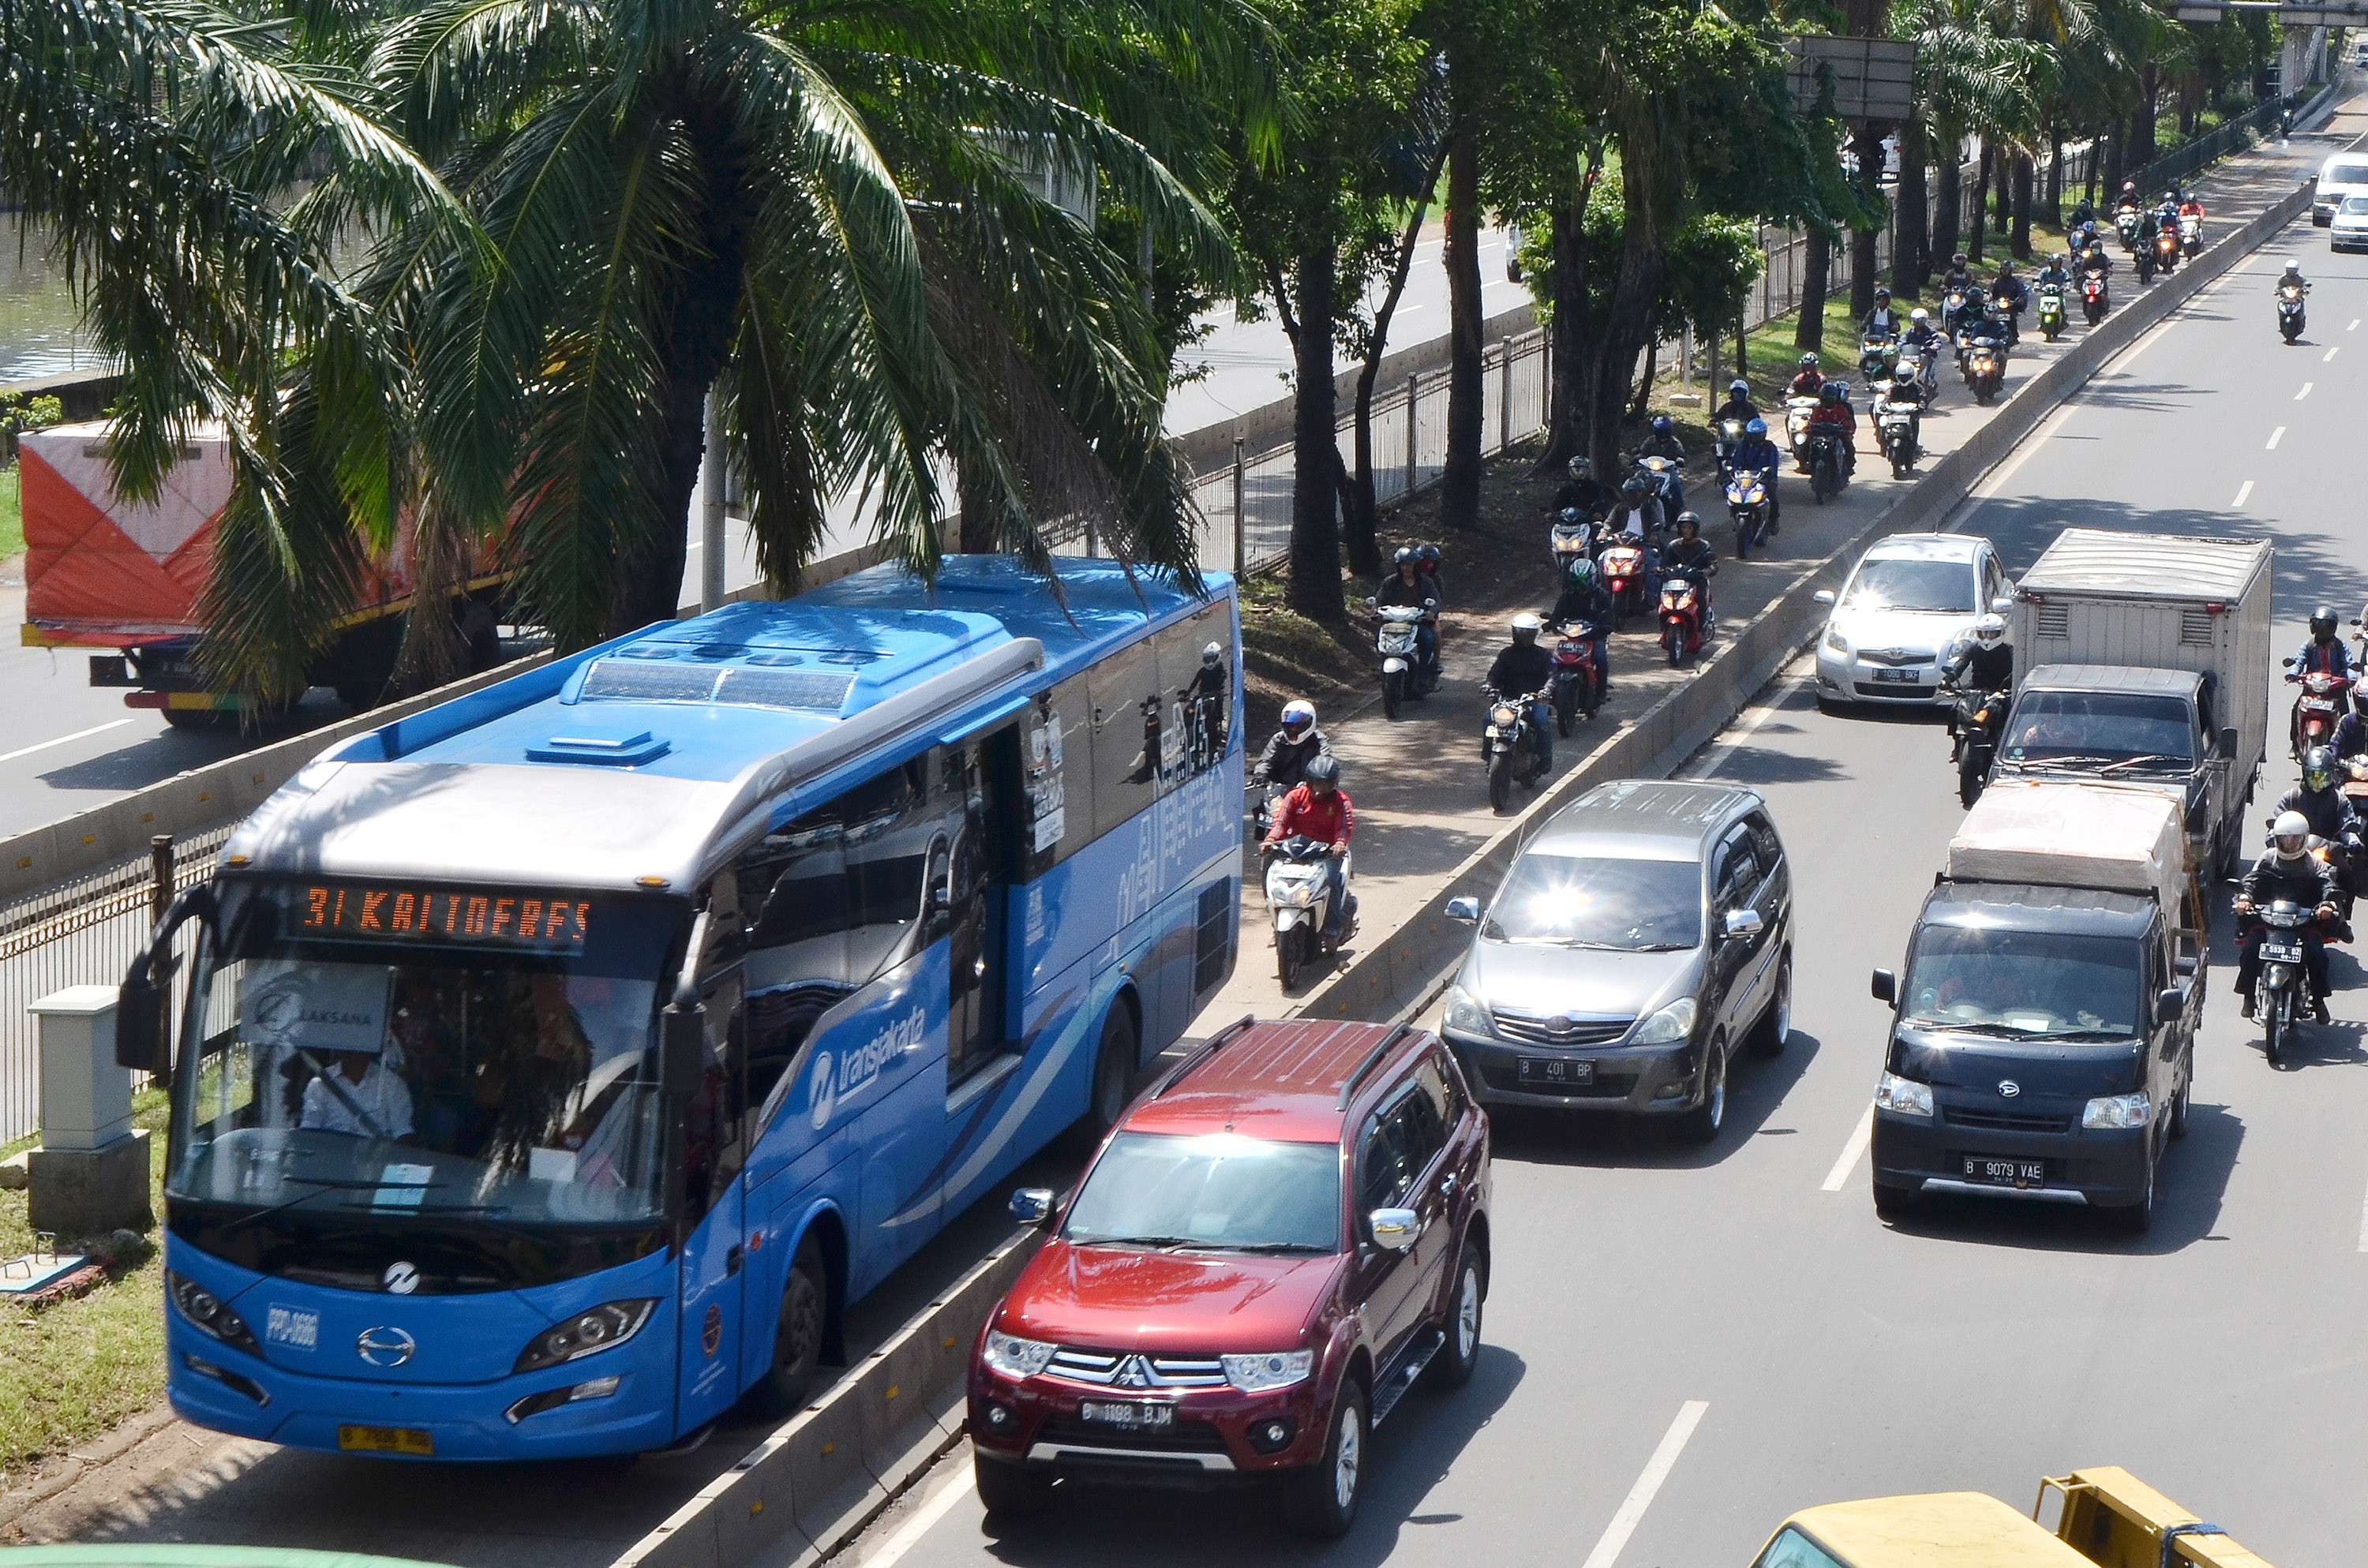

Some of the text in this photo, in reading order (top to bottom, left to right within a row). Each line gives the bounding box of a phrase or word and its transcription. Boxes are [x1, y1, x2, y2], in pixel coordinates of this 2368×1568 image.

[1522, 1060, 1530, 1074] B
[1546, 1061, 1564, 1076] 401
[1577, 1063, 1591, 1078] BP
[1965, 1160, 2041, 1180] B 9079 VAE
[1081, 1402, 1093, 1421] B
